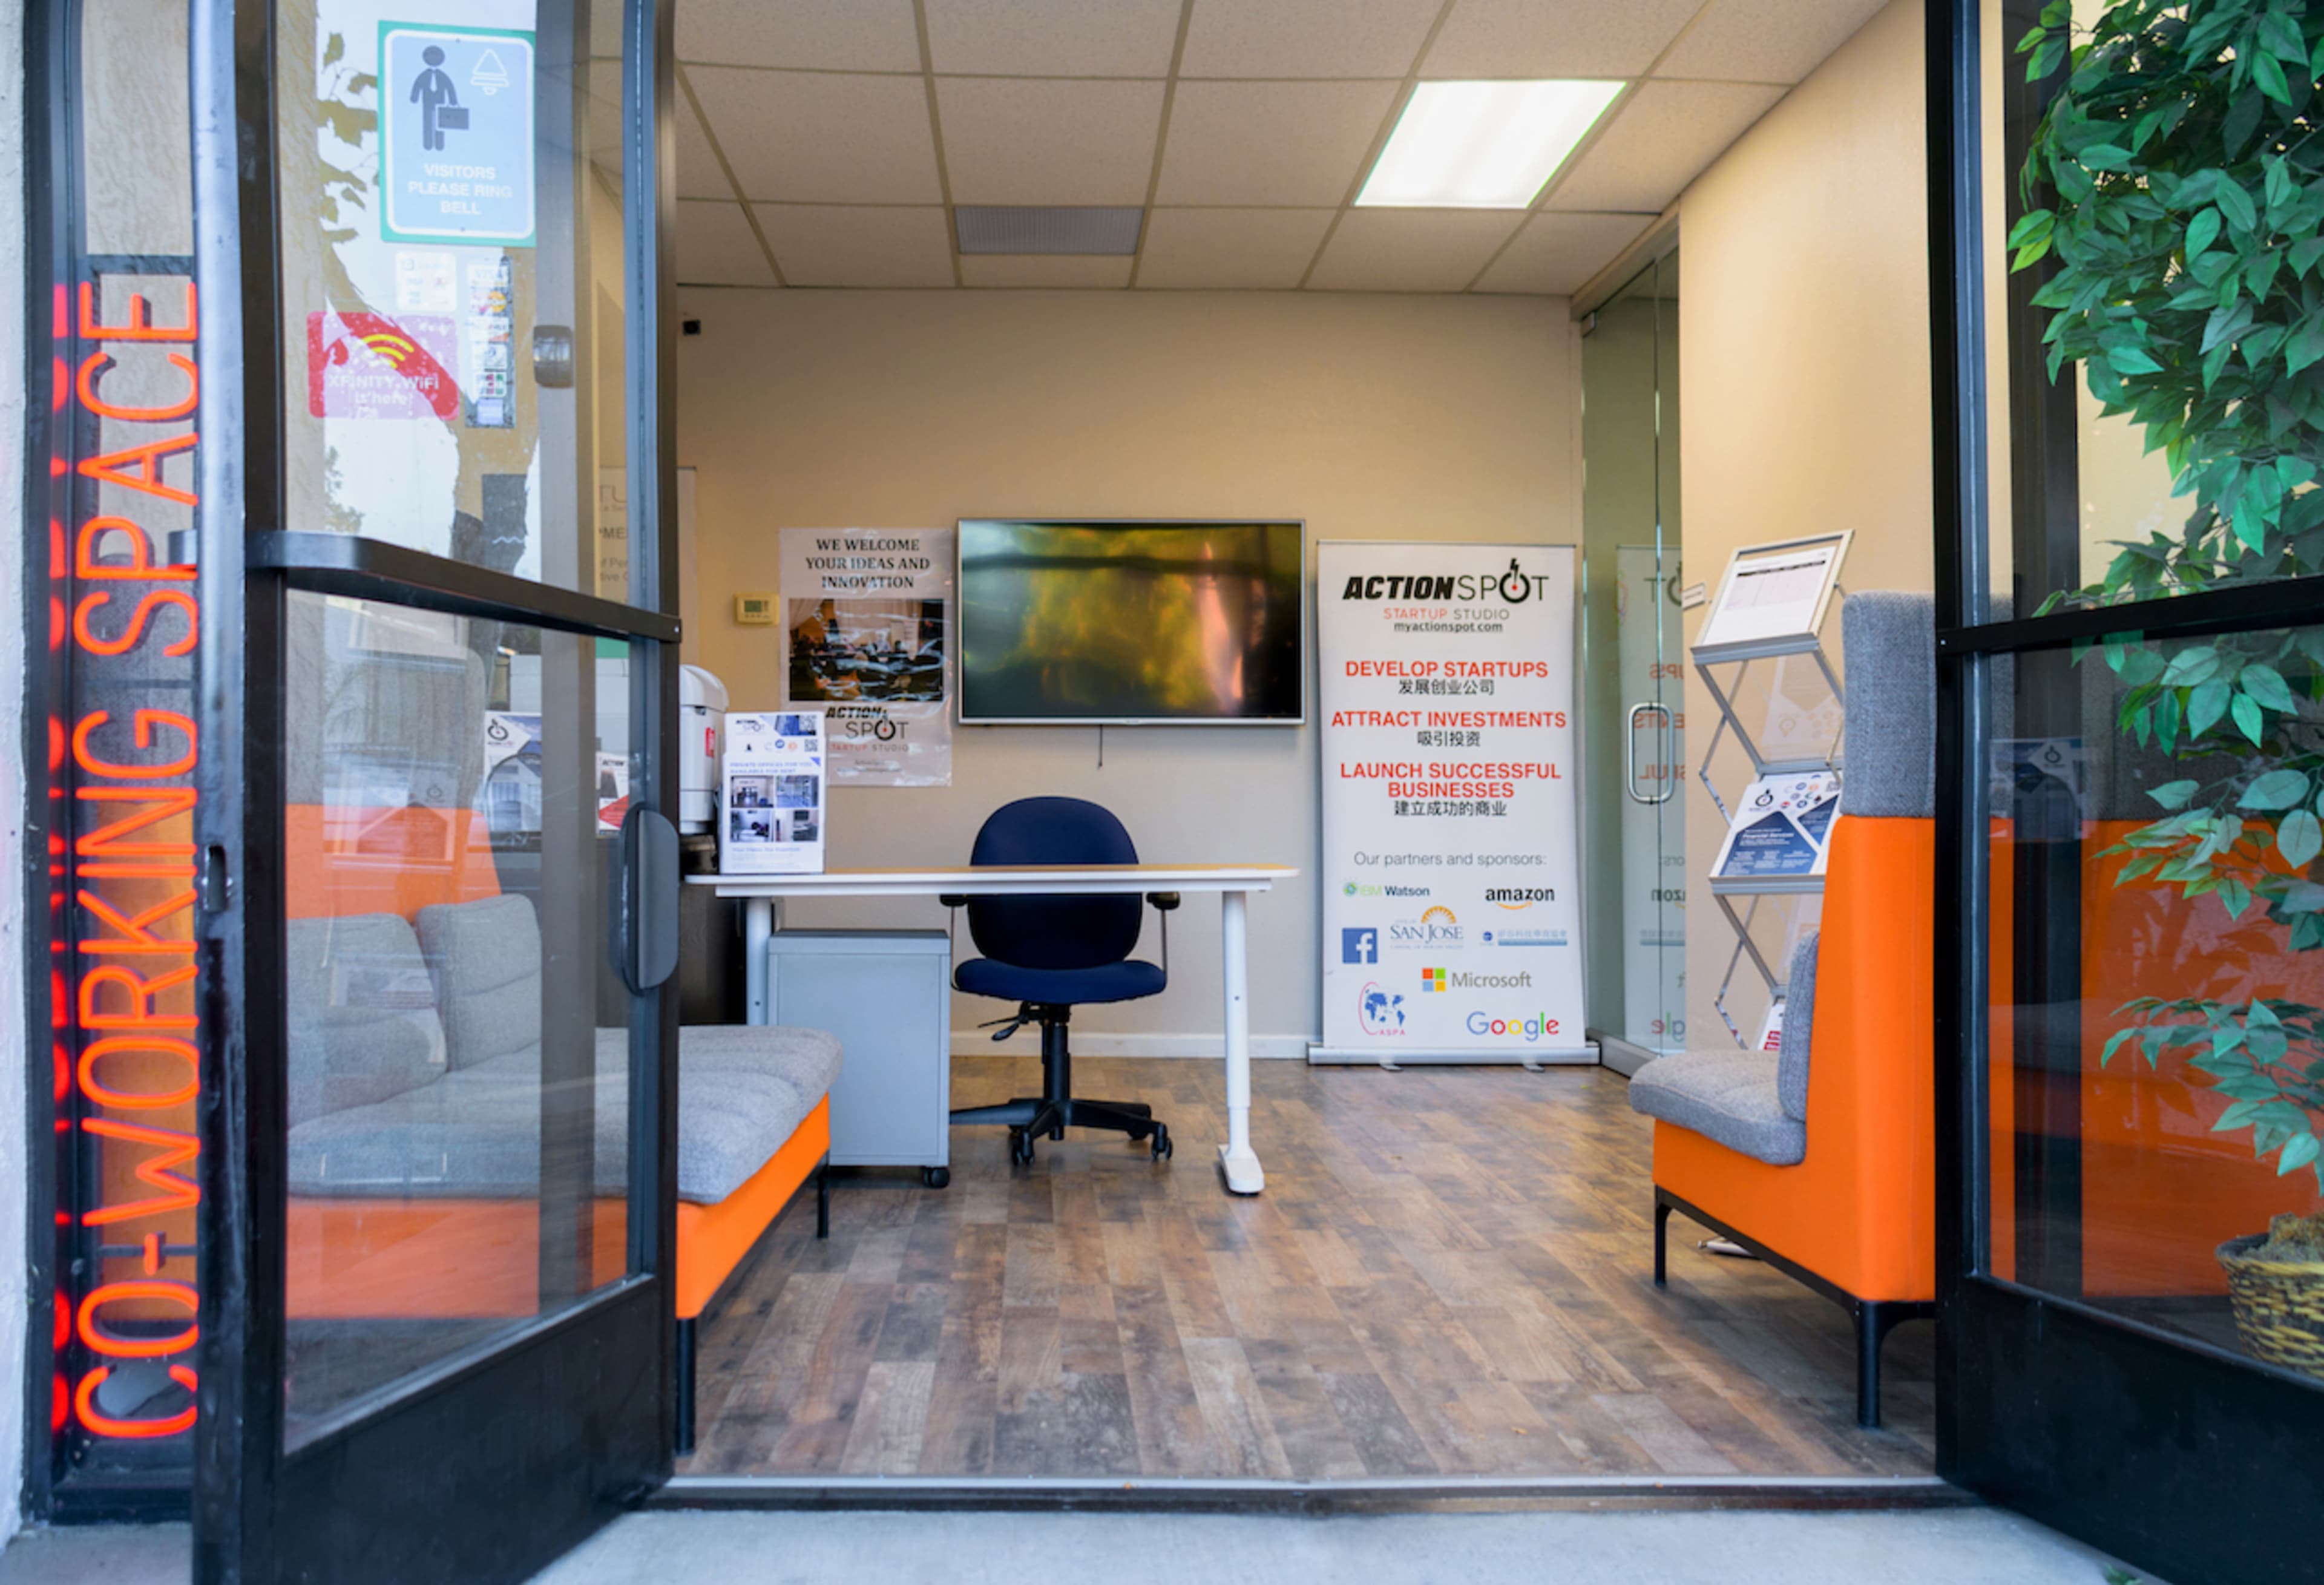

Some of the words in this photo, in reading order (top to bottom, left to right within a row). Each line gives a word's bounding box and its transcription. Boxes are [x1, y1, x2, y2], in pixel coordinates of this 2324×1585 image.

[423, 164, 496, 180] VISITORS
[408, 182, 470, 197] PLEASE
[474, 183, 512, 198] RING
[441, 200, 481, 215] BELL
[73, 281, 198, 656] SPACE
[816, 539, 841, 551] WE
[844, 539, 920, 551] WELCOME
[806, 557, 847, 570] YOUR
[851, 557, 894, 570] IDEAS
[898, 558, 930, 570] AND
[822, 576, 914, 588] INNOVATION
[1384, 608, 1447, 619] STARTUP
[1453, 609, 1509, 620] STUDIO
[1394, 622, 1503, 633] myactionspot.com
[1346, 661, 1437, 676] DEVELOP
[1444, 662, 1548, 677] STARTUPS
[1399, 680, 1495, 695] 发展创业公司
[1332, 712, 1422, 726] ATTRACT
[1428, 712, 1566, 727] INVESTMENTS
[1417, 732, 1480, 746] 吸引投资
[872, 744, 909, 752] STUDIO
[1341, 763, 1422, 778] LAUNCH
[1429, 764, 1561, 778] SUCCESSFUL
[1388, 782, 1514, 798] BUSINESSES
[1394, 801, 1507, 816] 建立成功的商业
[1354, 852, 1379, 865] Our
[1385, 853, 1442, 867] partners
[1446, 853, 1473, 865] and
[1477, 855, 1546, 867] sponsors:
[1385, 885, 1430, 896] Watson
[1485, 888, 1555, 901] amazon
[1390, 925, 1424, 940] SAN
[1425, 924, 1463, 944] JOSE
[1452, 972, 1531, 988] Microsoft
[1466, 1012, 1559, 1042] Google
[75, 709, 198, 1437] CO-WORKING
